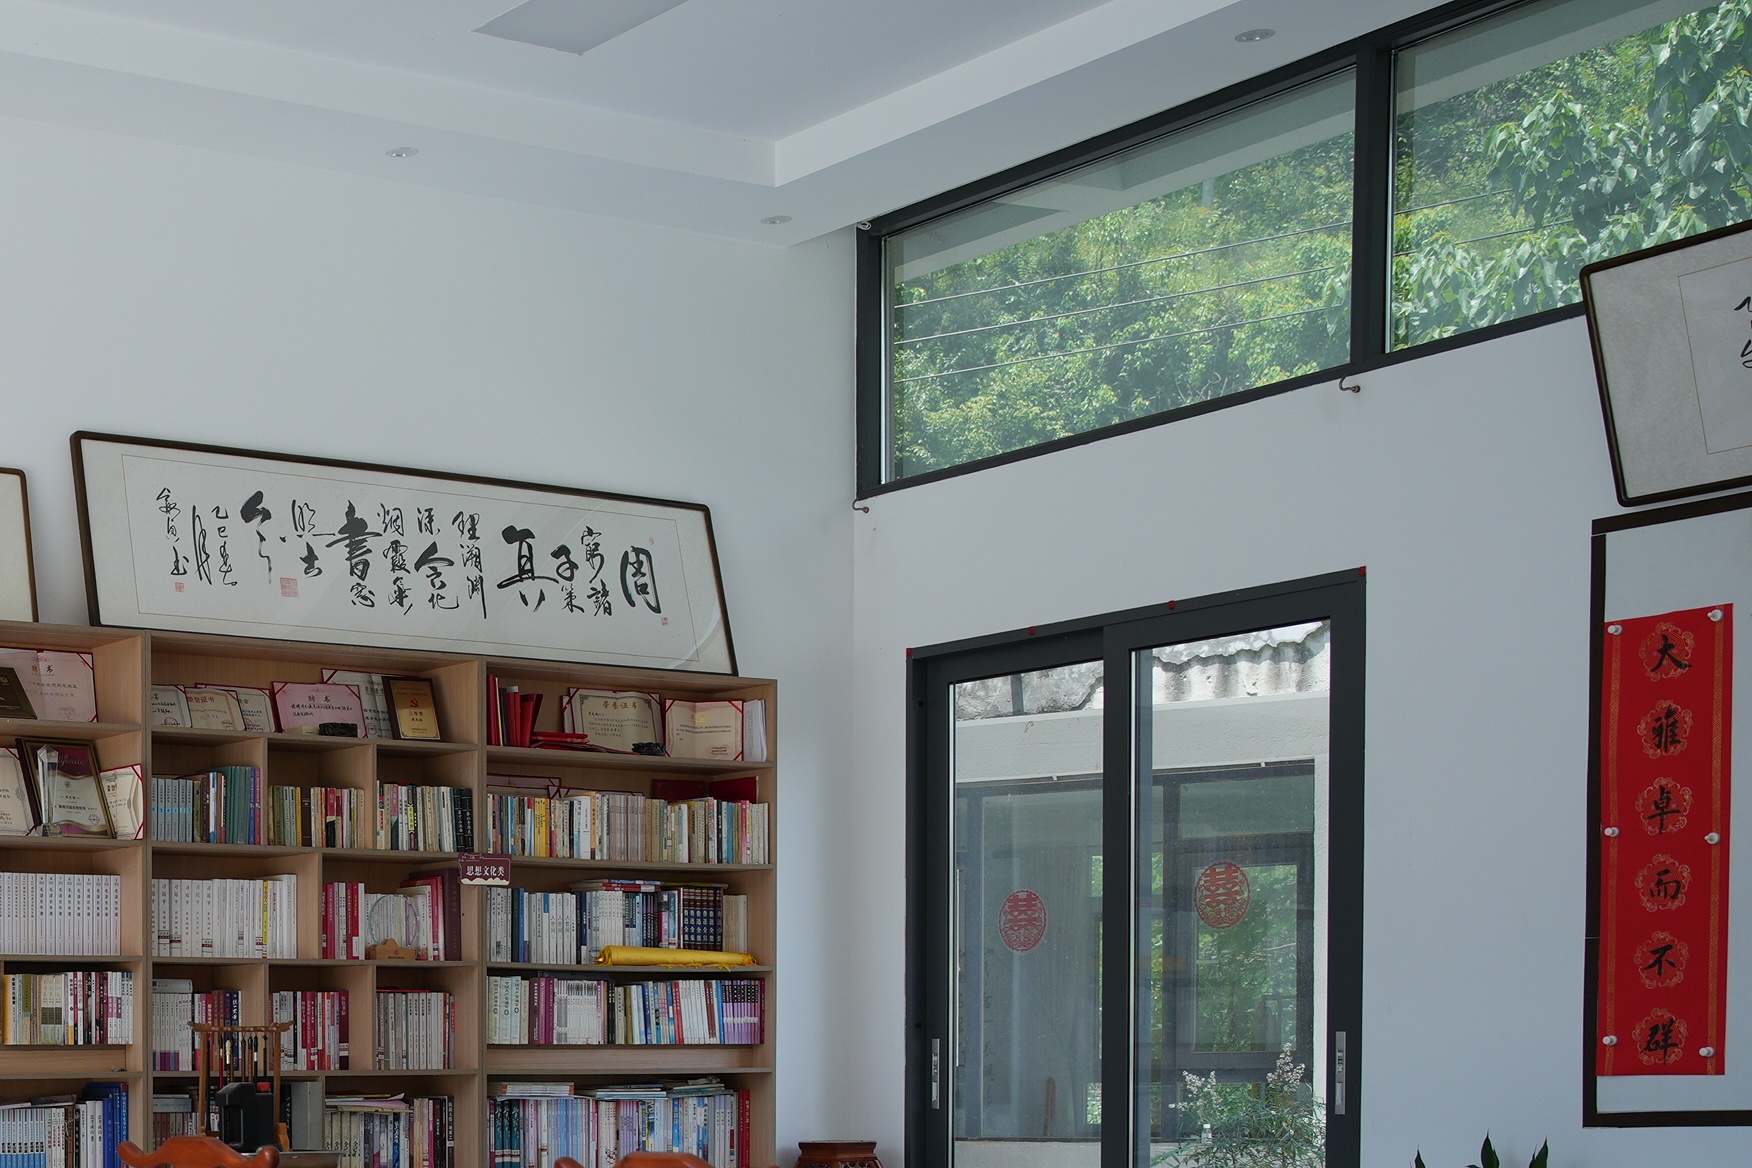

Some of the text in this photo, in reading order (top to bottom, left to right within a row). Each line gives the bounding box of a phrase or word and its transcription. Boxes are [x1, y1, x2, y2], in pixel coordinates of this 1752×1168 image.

[466, 865, 505, 876] 思想文化类
[1643, 632, 1692, 1066] 大雅卓而不群
